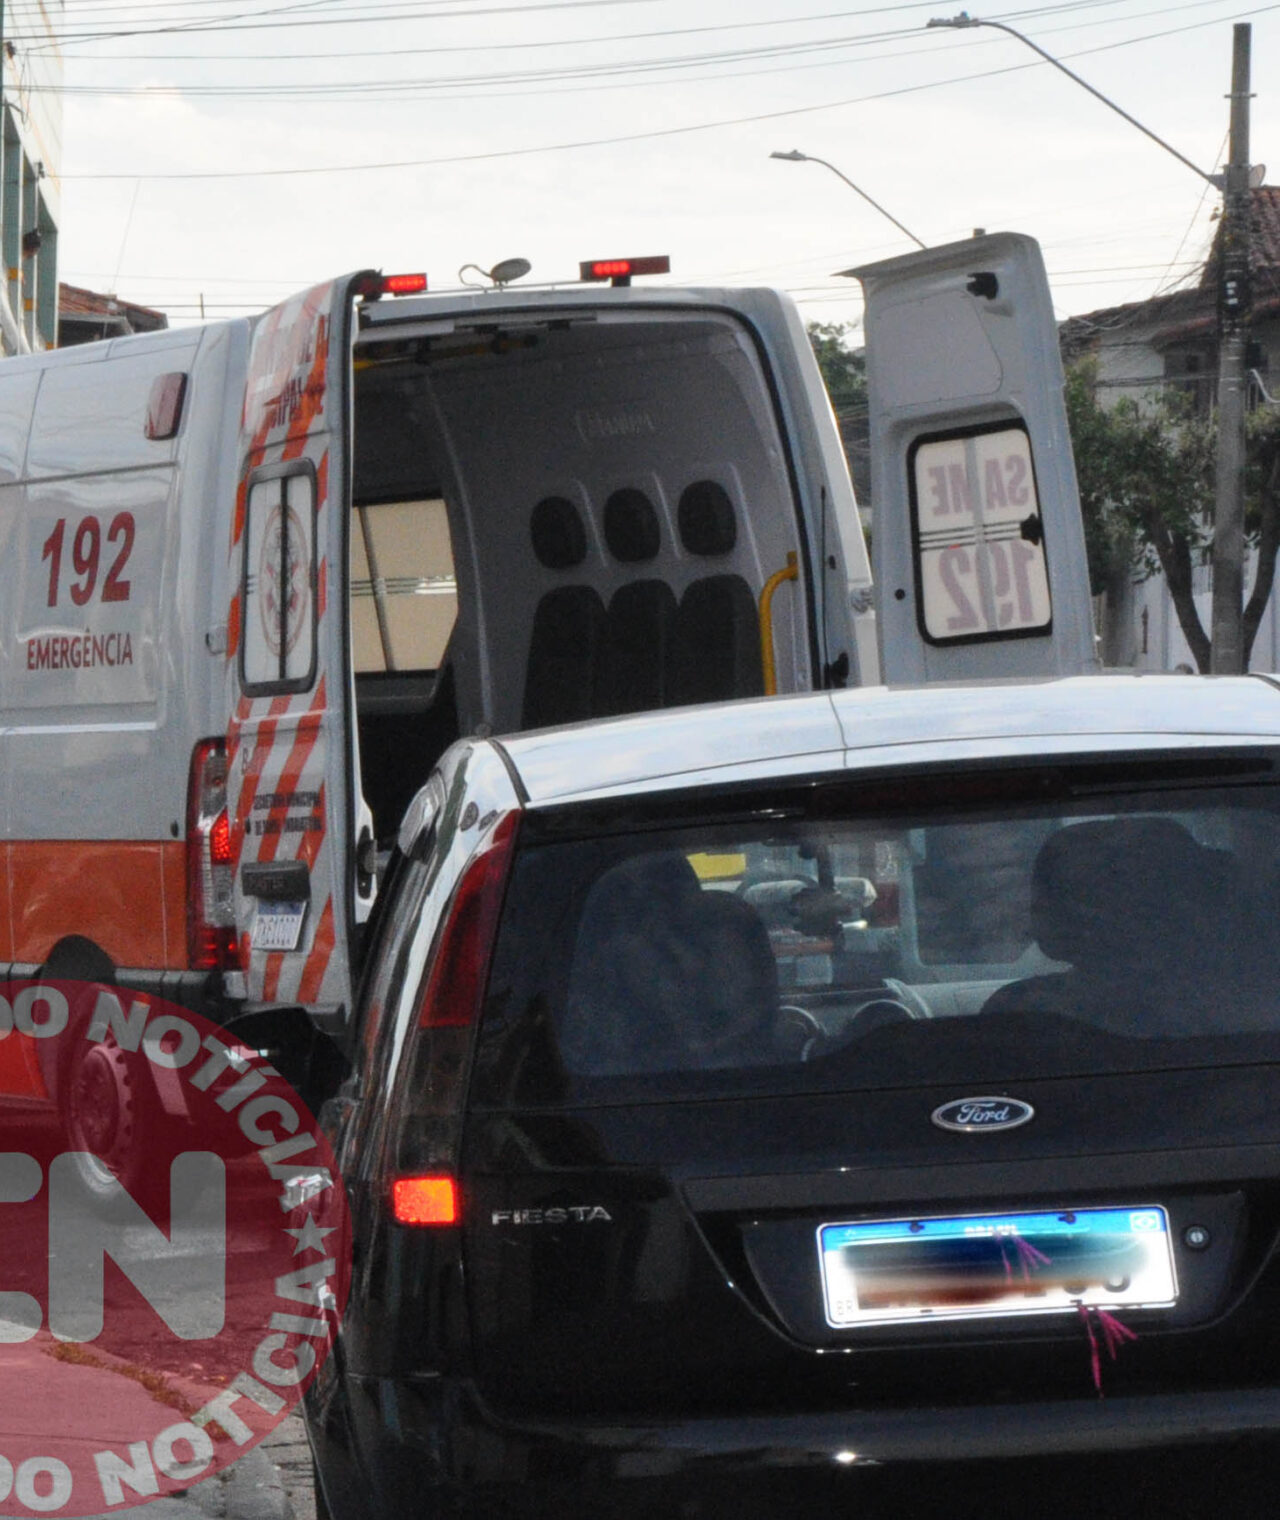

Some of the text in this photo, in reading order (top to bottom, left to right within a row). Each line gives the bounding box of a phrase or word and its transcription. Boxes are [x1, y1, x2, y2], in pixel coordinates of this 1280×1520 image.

[42, 511, 136, 608] 192
[27, 626, 134, 671] EMERGÊNCIA
[956, 1102, 1010, 1123] Ford
[492, 1206, 612, 1225] FIESTA
